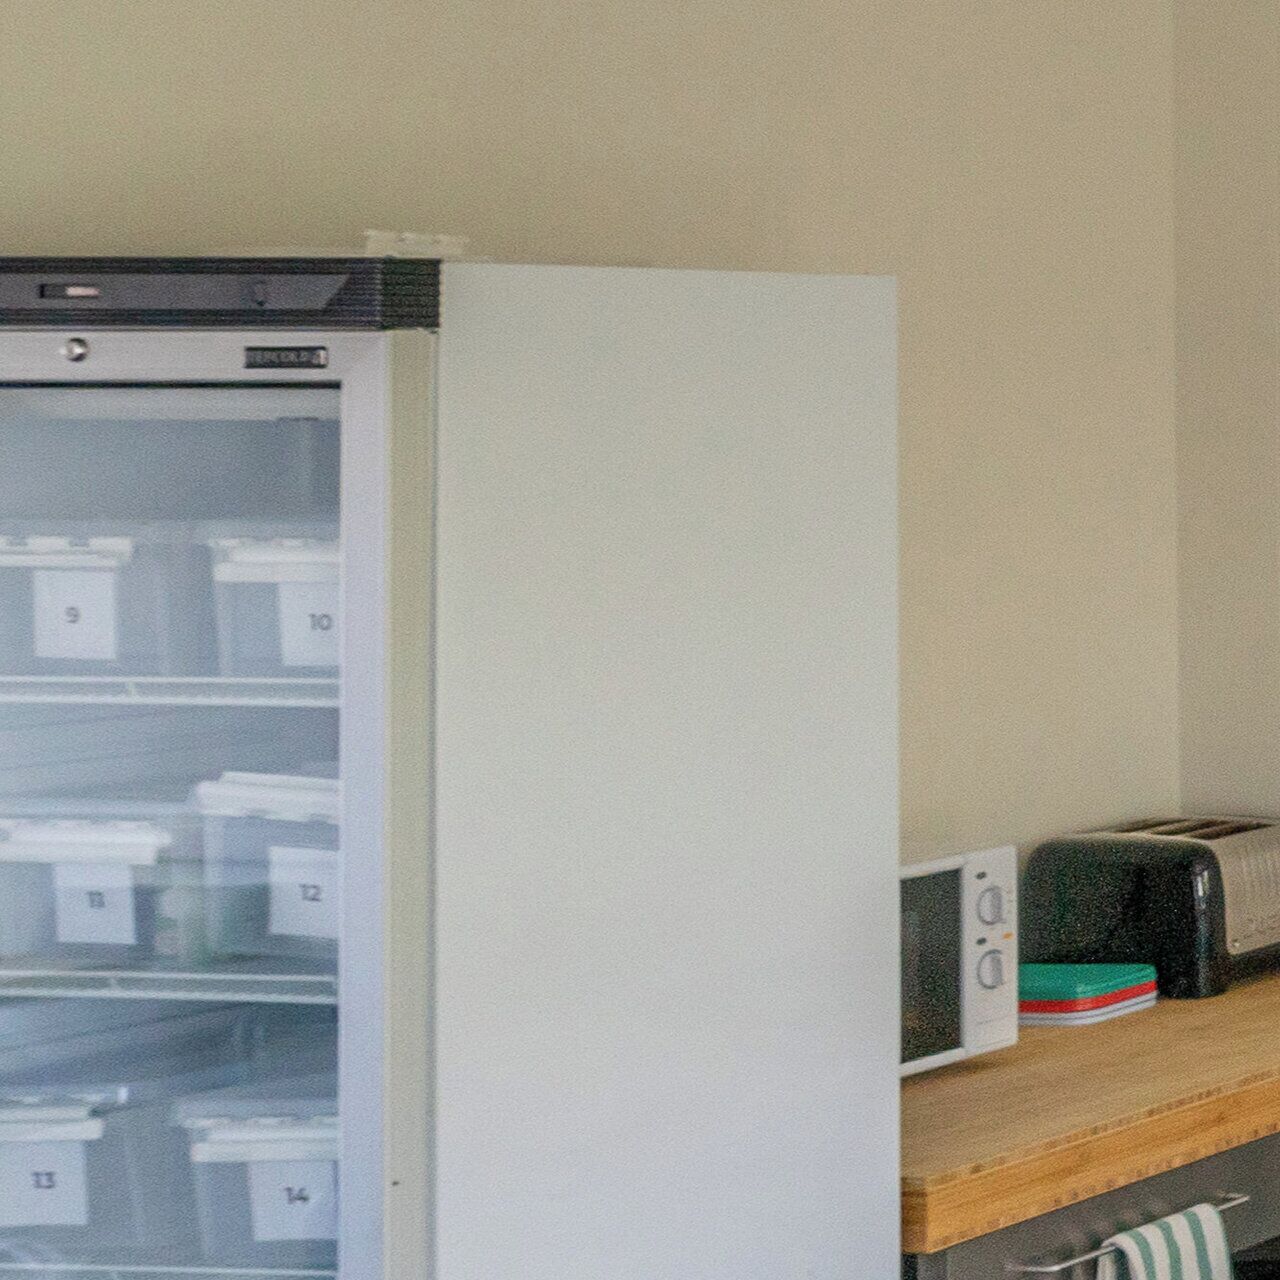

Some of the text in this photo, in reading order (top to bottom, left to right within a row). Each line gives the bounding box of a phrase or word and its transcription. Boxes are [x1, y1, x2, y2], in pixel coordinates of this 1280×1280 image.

[66, 606, 80, 624] 9
[309, 613, 332, 631] 10
[300, 883, 322, 902] 12
[31, 1170, 56, 1189] 13
[285, 1185, 310, 1205] 14
